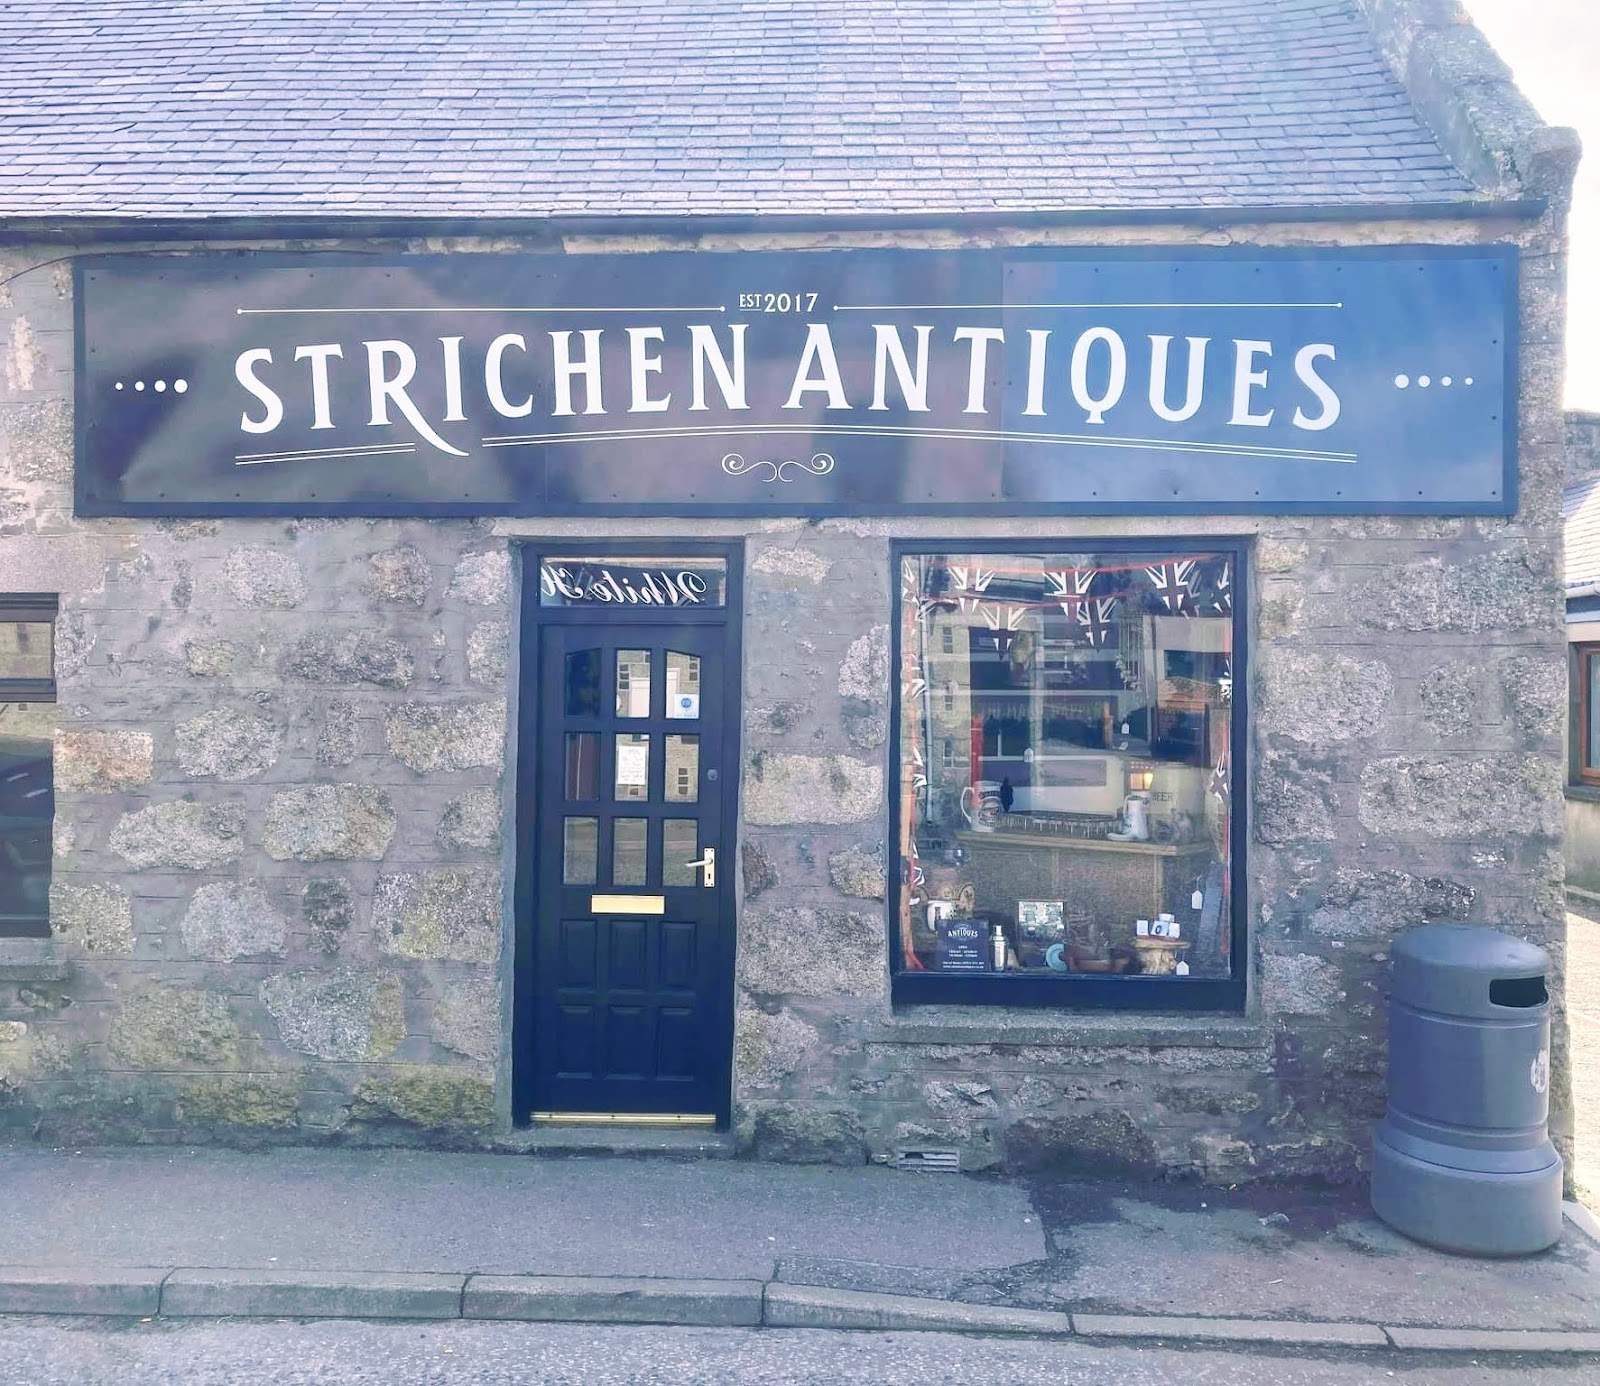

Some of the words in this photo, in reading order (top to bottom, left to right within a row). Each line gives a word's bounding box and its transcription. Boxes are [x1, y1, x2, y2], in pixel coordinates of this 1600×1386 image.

[739, 293, 762, 311] EST
[764, 292, 819, 313] 2017
[234, 323, 751, 457] STRICHEN
[781, 322, 1342, 431] ANTIQUES
